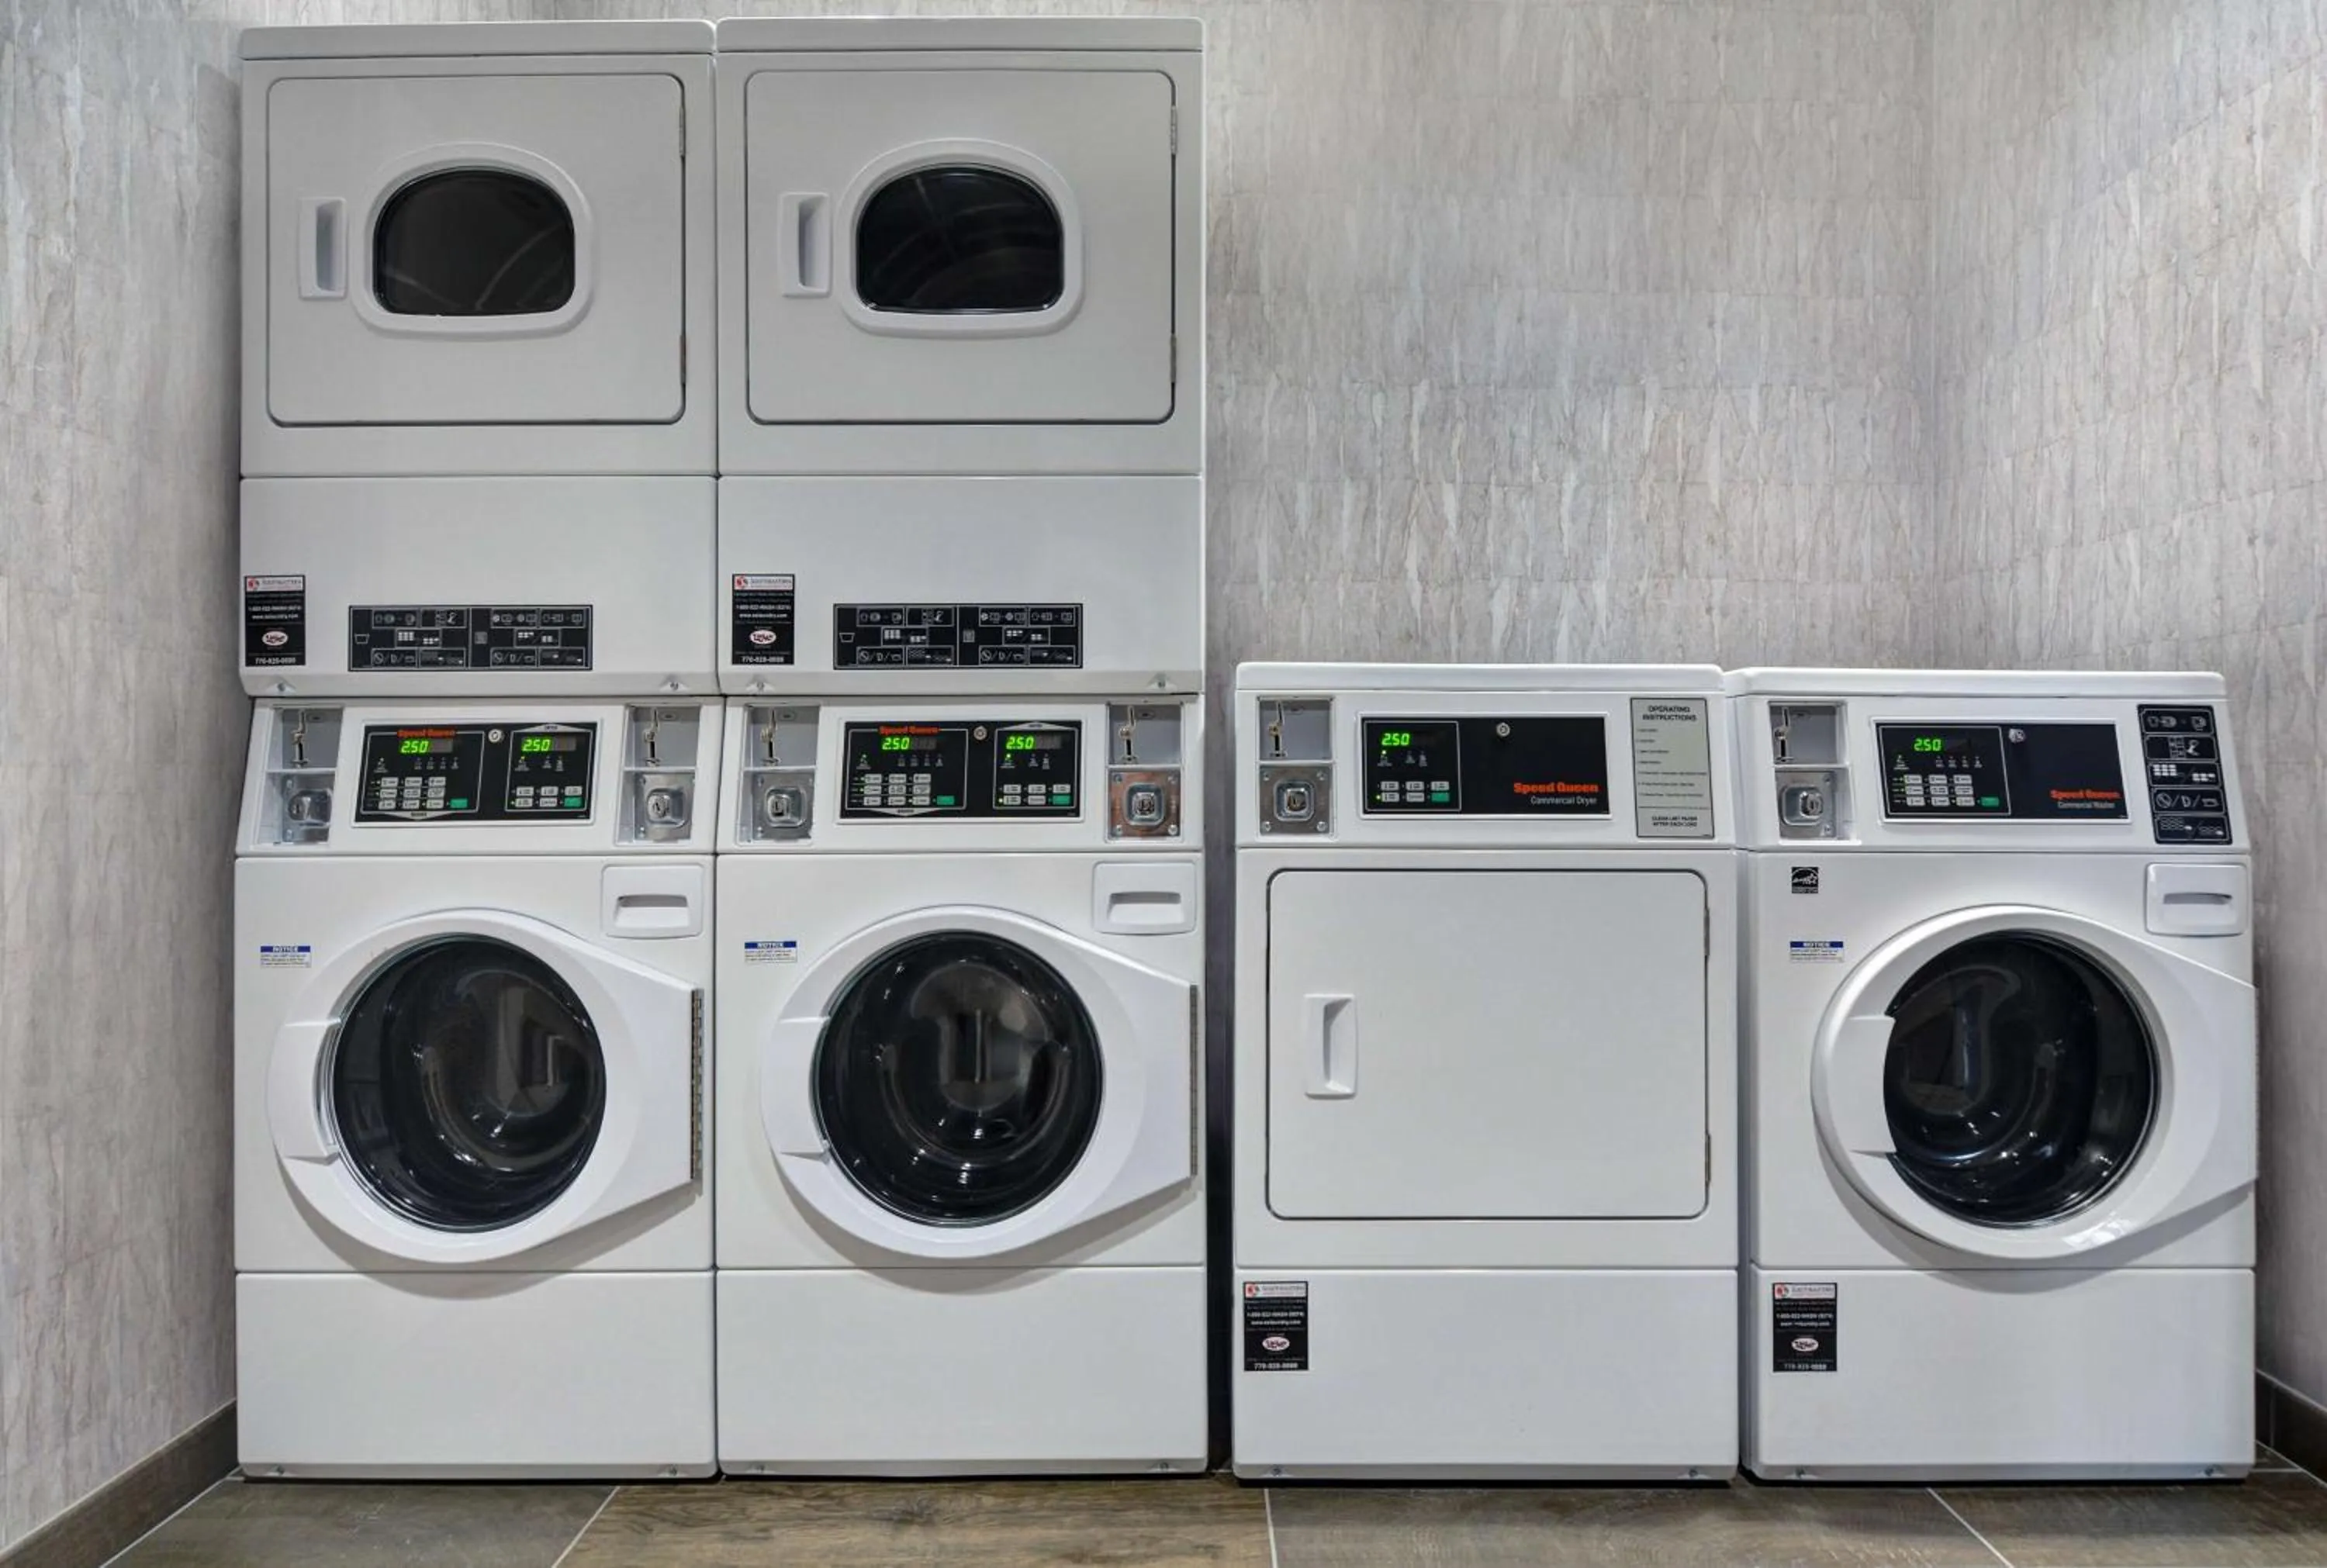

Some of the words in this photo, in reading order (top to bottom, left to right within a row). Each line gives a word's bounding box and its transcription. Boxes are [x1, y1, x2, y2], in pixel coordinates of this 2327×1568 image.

[1513, 782, 1554, 794] Speed
[1557, 782, 1599, 793] Queen
[1530, 796, 1575, 805] Commercial
[1576, 796, 1597, 806] Dryer
